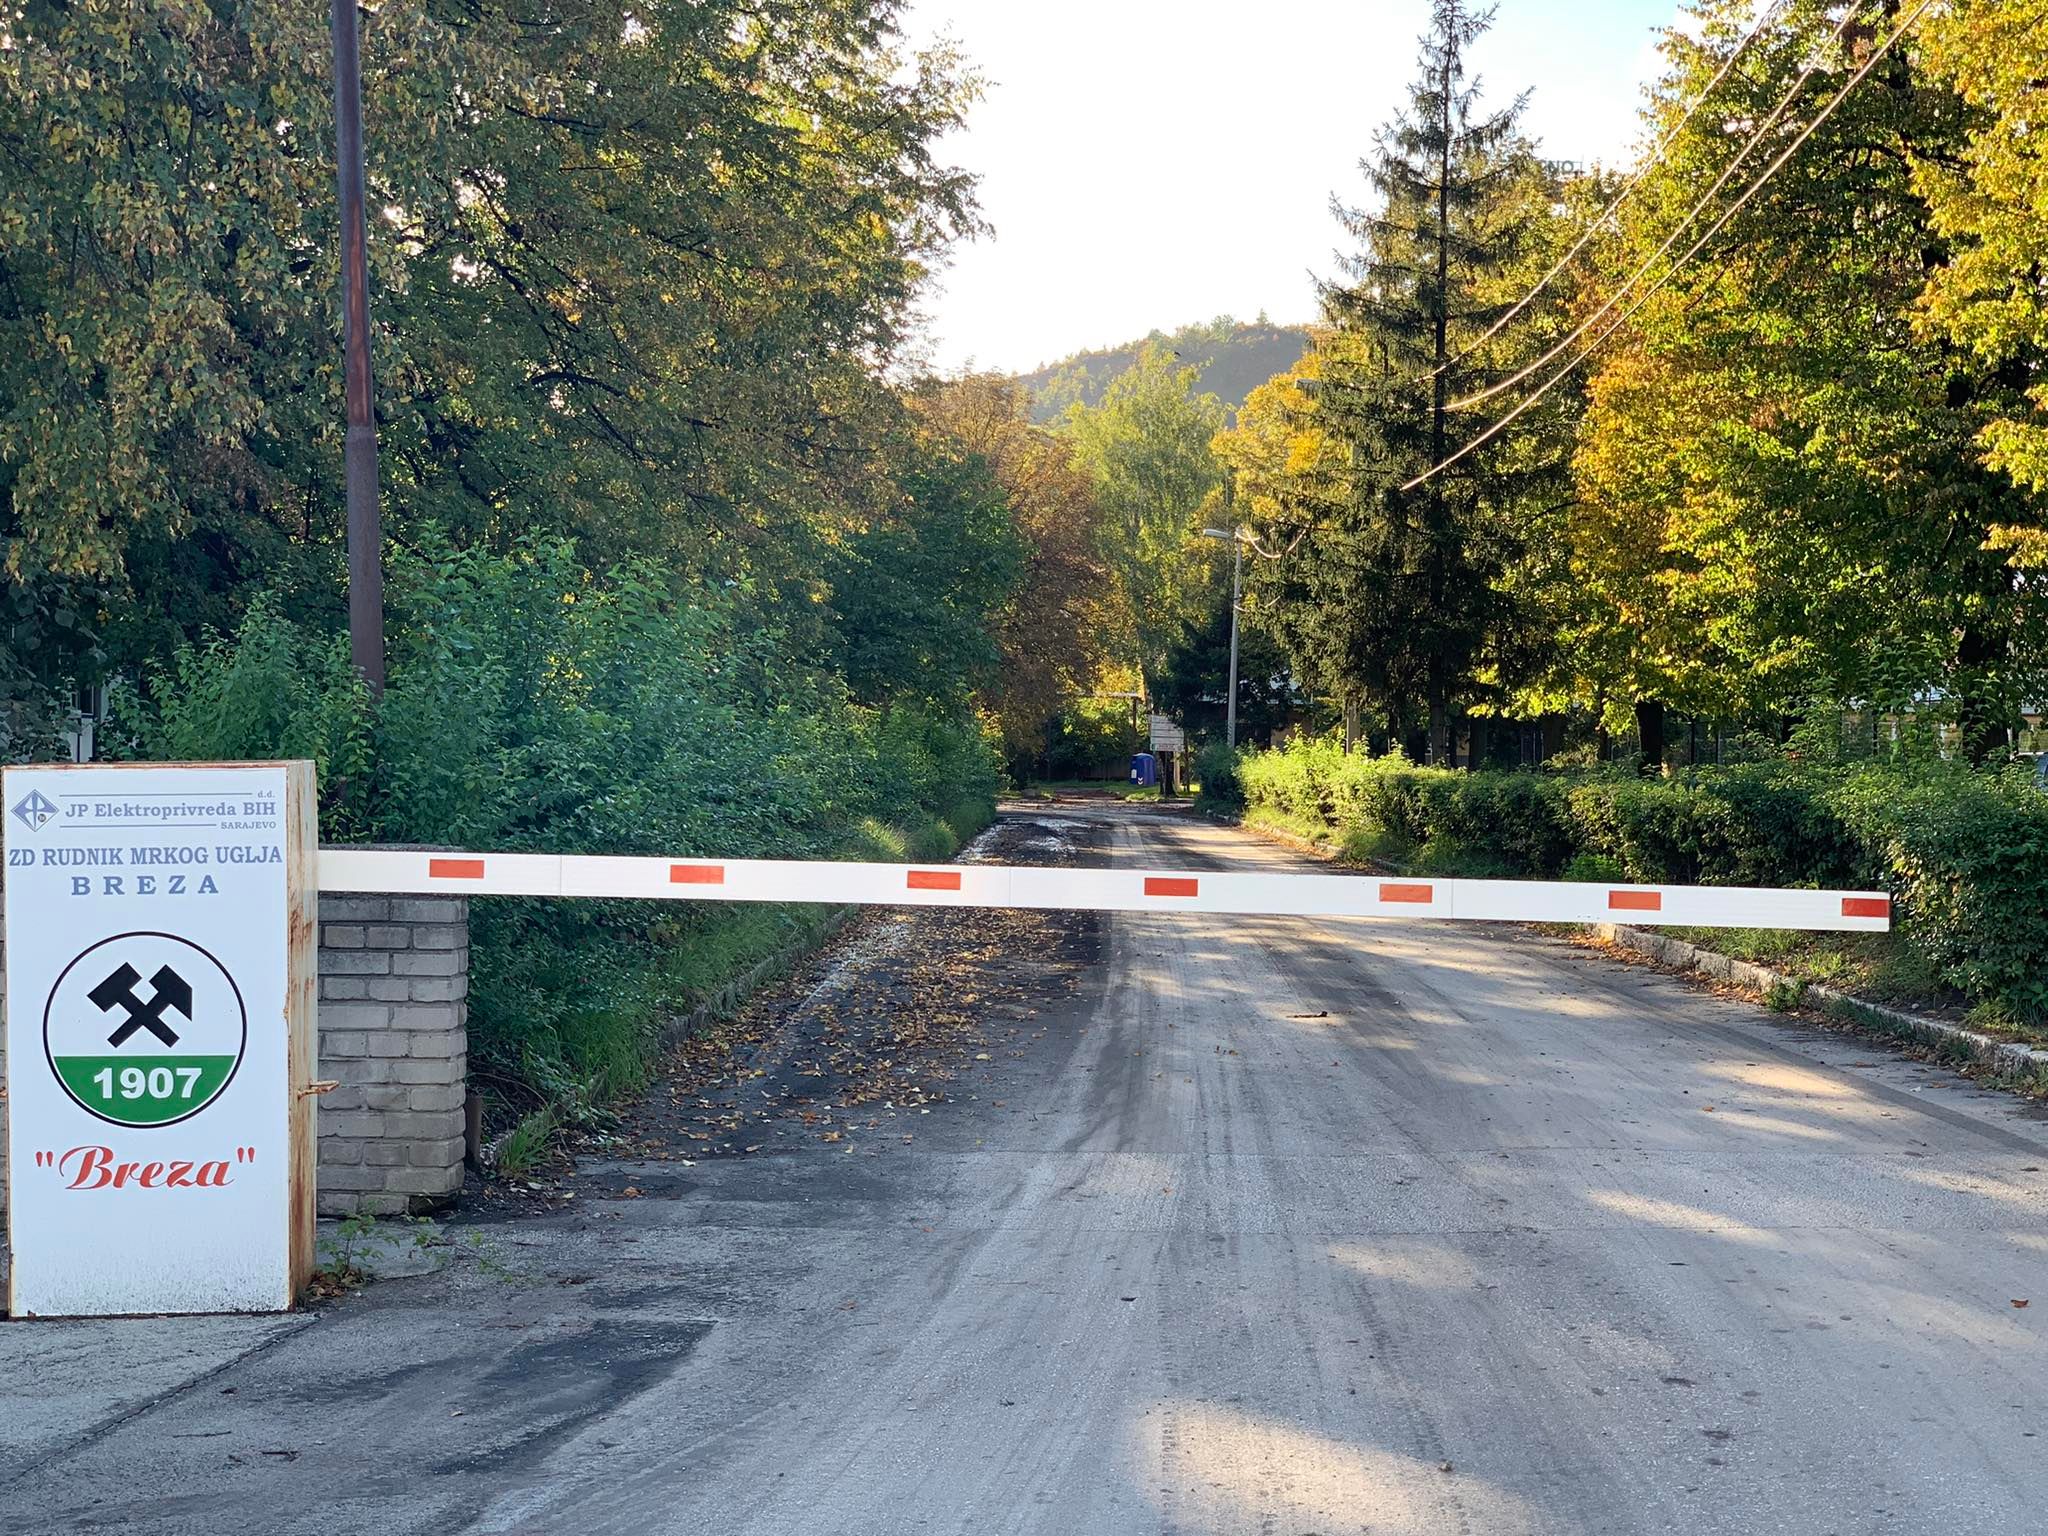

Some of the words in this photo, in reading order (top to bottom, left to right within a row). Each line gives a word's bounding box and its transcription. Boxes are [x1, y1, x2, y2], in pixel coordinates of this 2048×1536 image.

[257, 790, 276, 799] d.d.
[65, 803, 89, 818] JP
[94, 802, 237, 820] Elektroprivreda
[243, 801, 277, 816] BIH
[220, 821, 277, 830] SARAJEVO
[9, 848, 36, 867] ZD
[42, 847, 124, 866] RUDNIK
[130, 846, 209, 865] MRKOG
[215, 846, 283, 864] UGLJA
[93, 1067, 202, 1100] 1907
[35, 1145, 256, 1191] "Breza"
